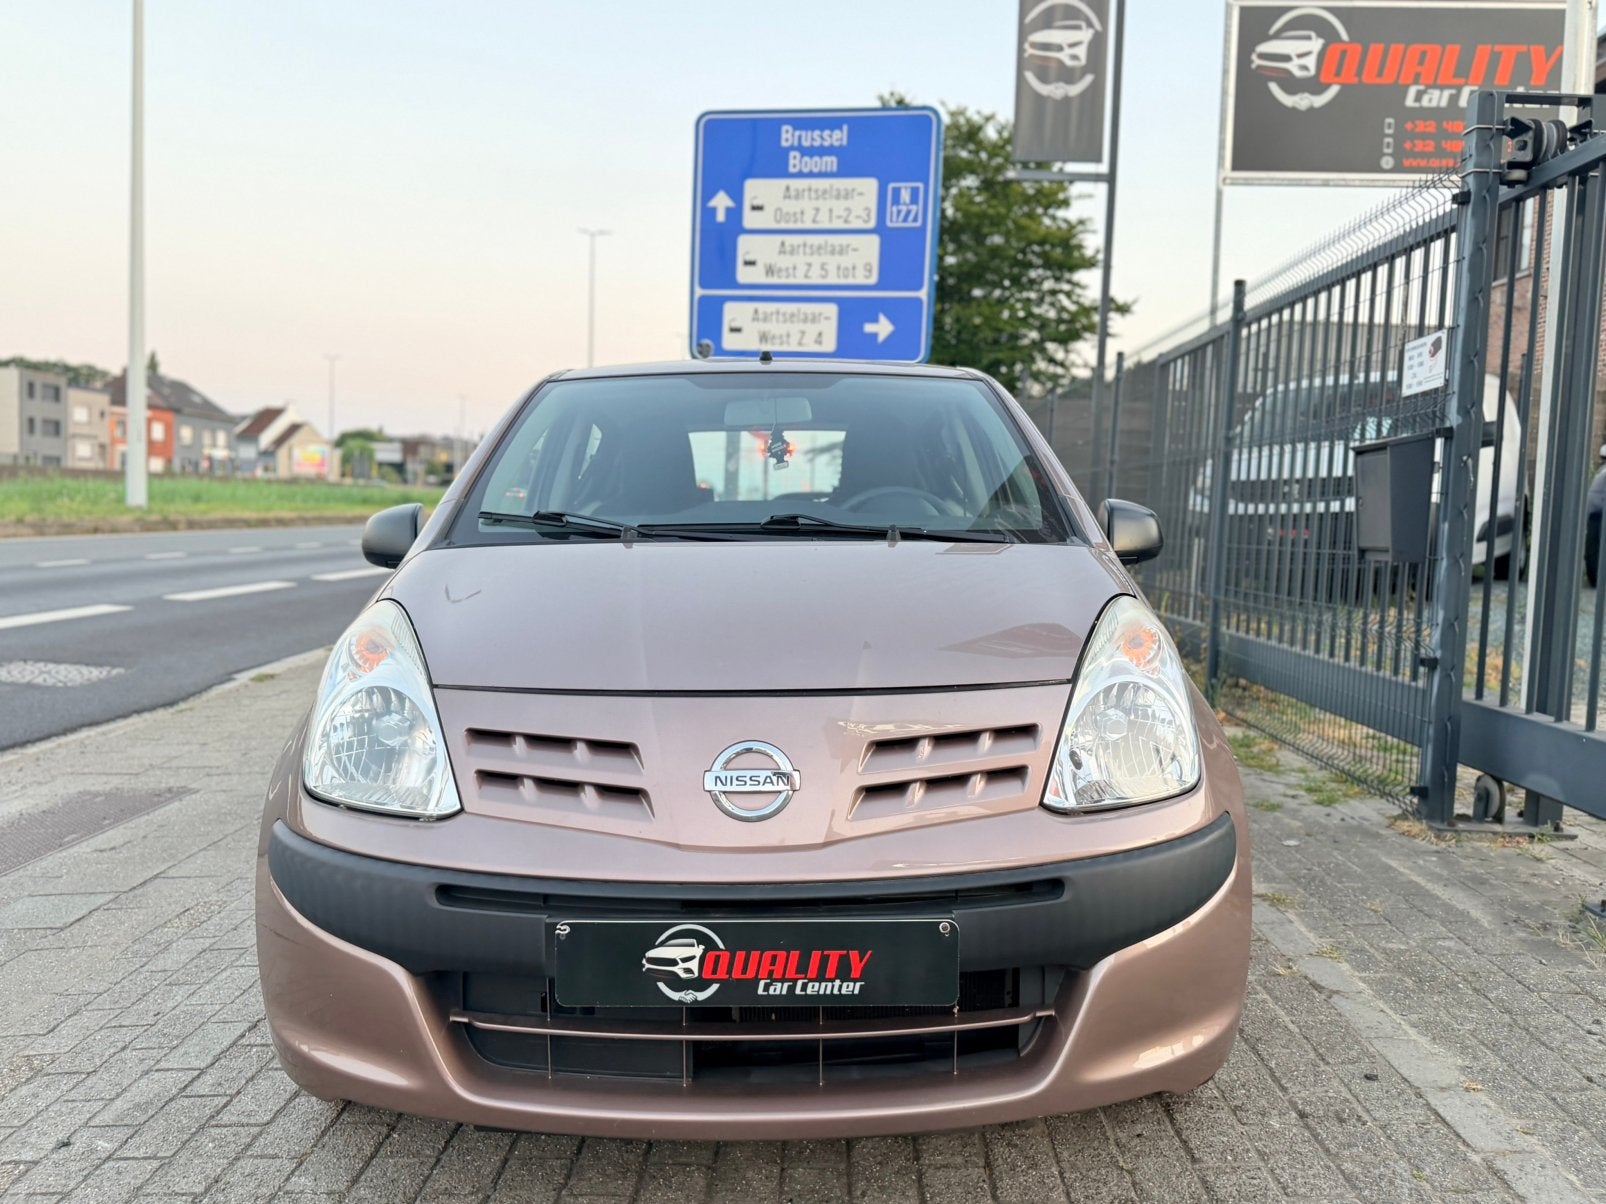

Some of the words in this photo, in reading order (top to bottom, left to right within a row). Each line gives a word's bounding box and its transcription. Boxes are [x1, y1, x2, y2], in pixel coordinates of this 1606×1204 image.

[1319, 42, 1565, 87] QUALITY
[1404, 84, 1457, 108] Car
[781, 124, 848, 147] Brussel
[788, 151, 838, 173] Boom
[782, 184, 865, 201] Aartselaar-
[900, 187, 912, 204] N
[773, 207, 805, 224] Oost
[891, 205, 919, 223] 177
[777, 240, 860, 257] Aartselaar-
[763, 262, 798, 280] West
[835, 263, 857, 280] tot
[863, 261, 873, 280] 9
[751, 307, 832, 324] Aartselaar-
[758, 329, 791, 347] West
[813, 330, 823, 347] 4
[714, 775, 790, 787] NISSAN
[702, 950, 873, 980] QUALITY
[757, 979, 793, 995] Car
[794, 979, 865, 995] Center
